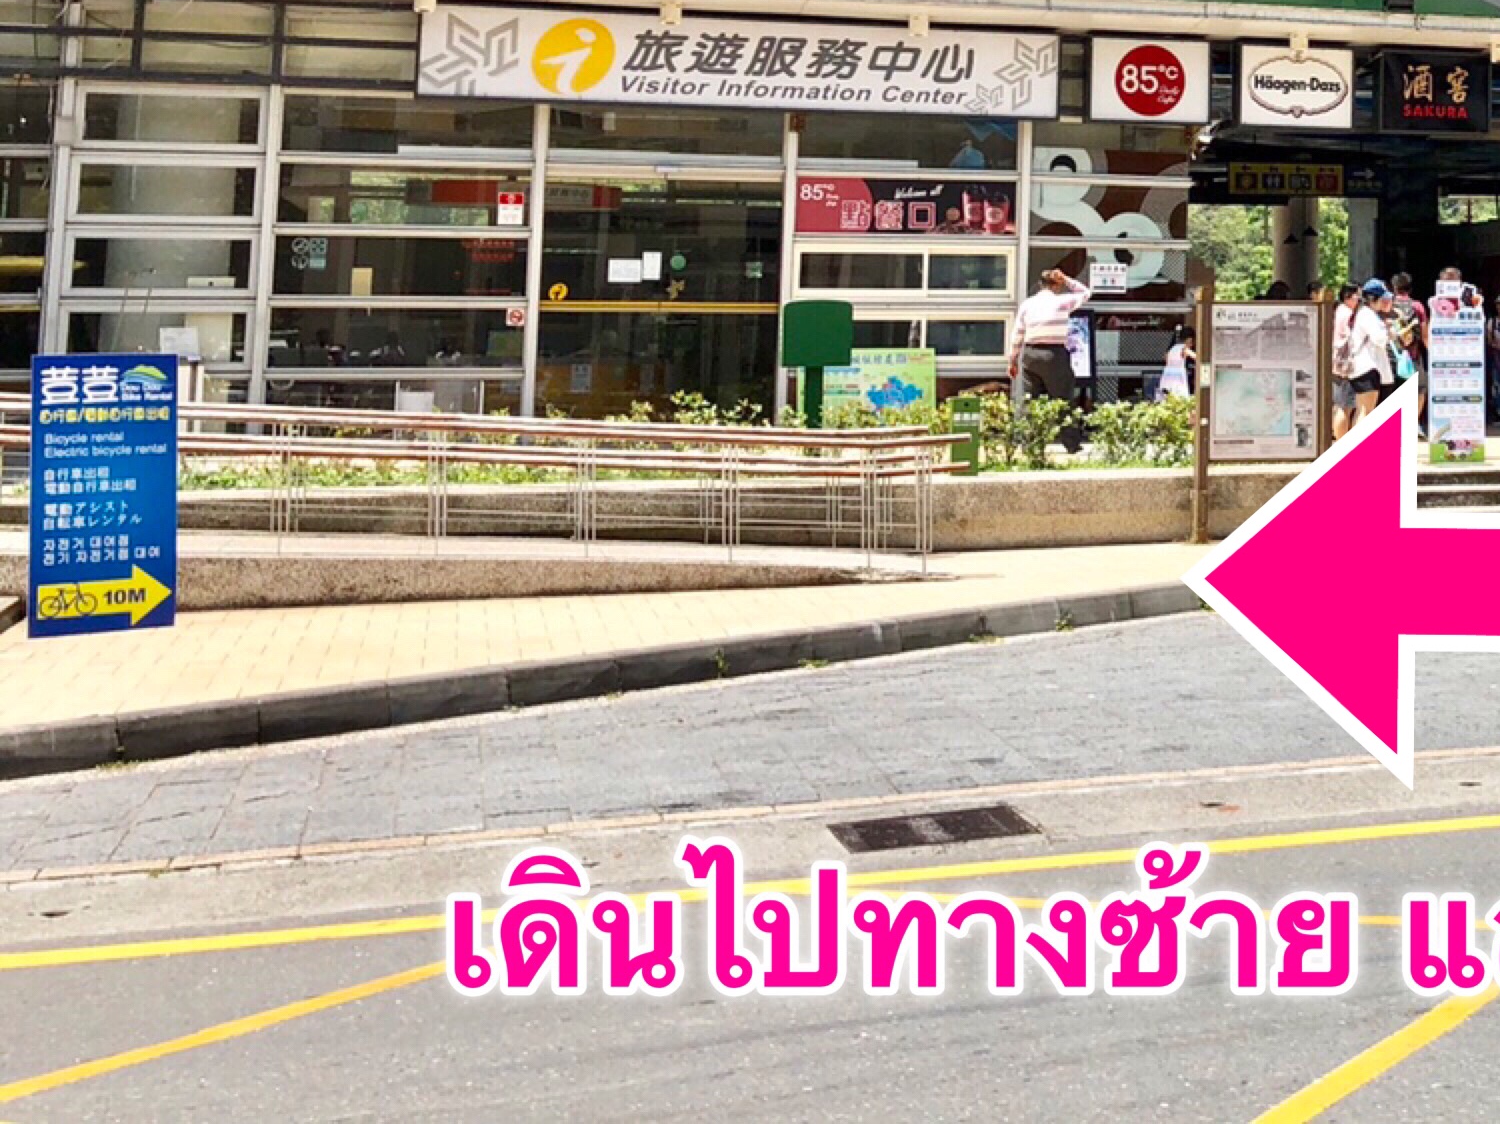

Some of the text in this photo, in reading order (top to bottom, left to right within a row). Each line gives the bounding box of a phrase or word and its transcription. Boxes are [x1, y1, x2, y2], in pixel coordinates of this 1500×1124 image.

[622, 29, 974, 83] 旅遊服務中心
[621, 74, 967, 105] Visitor Information Center
[1254, 75, 1341, 95] Häagen-Dazs
[1403, 105, 1468, 118] SAKURA
[41, 366, 119, 404] 荳荳
[44, 431, 125, 446] Bicycle rental
[44, 444, 167, 458] Electric bicycle rental
[103, 588, 147, 604] 10M
